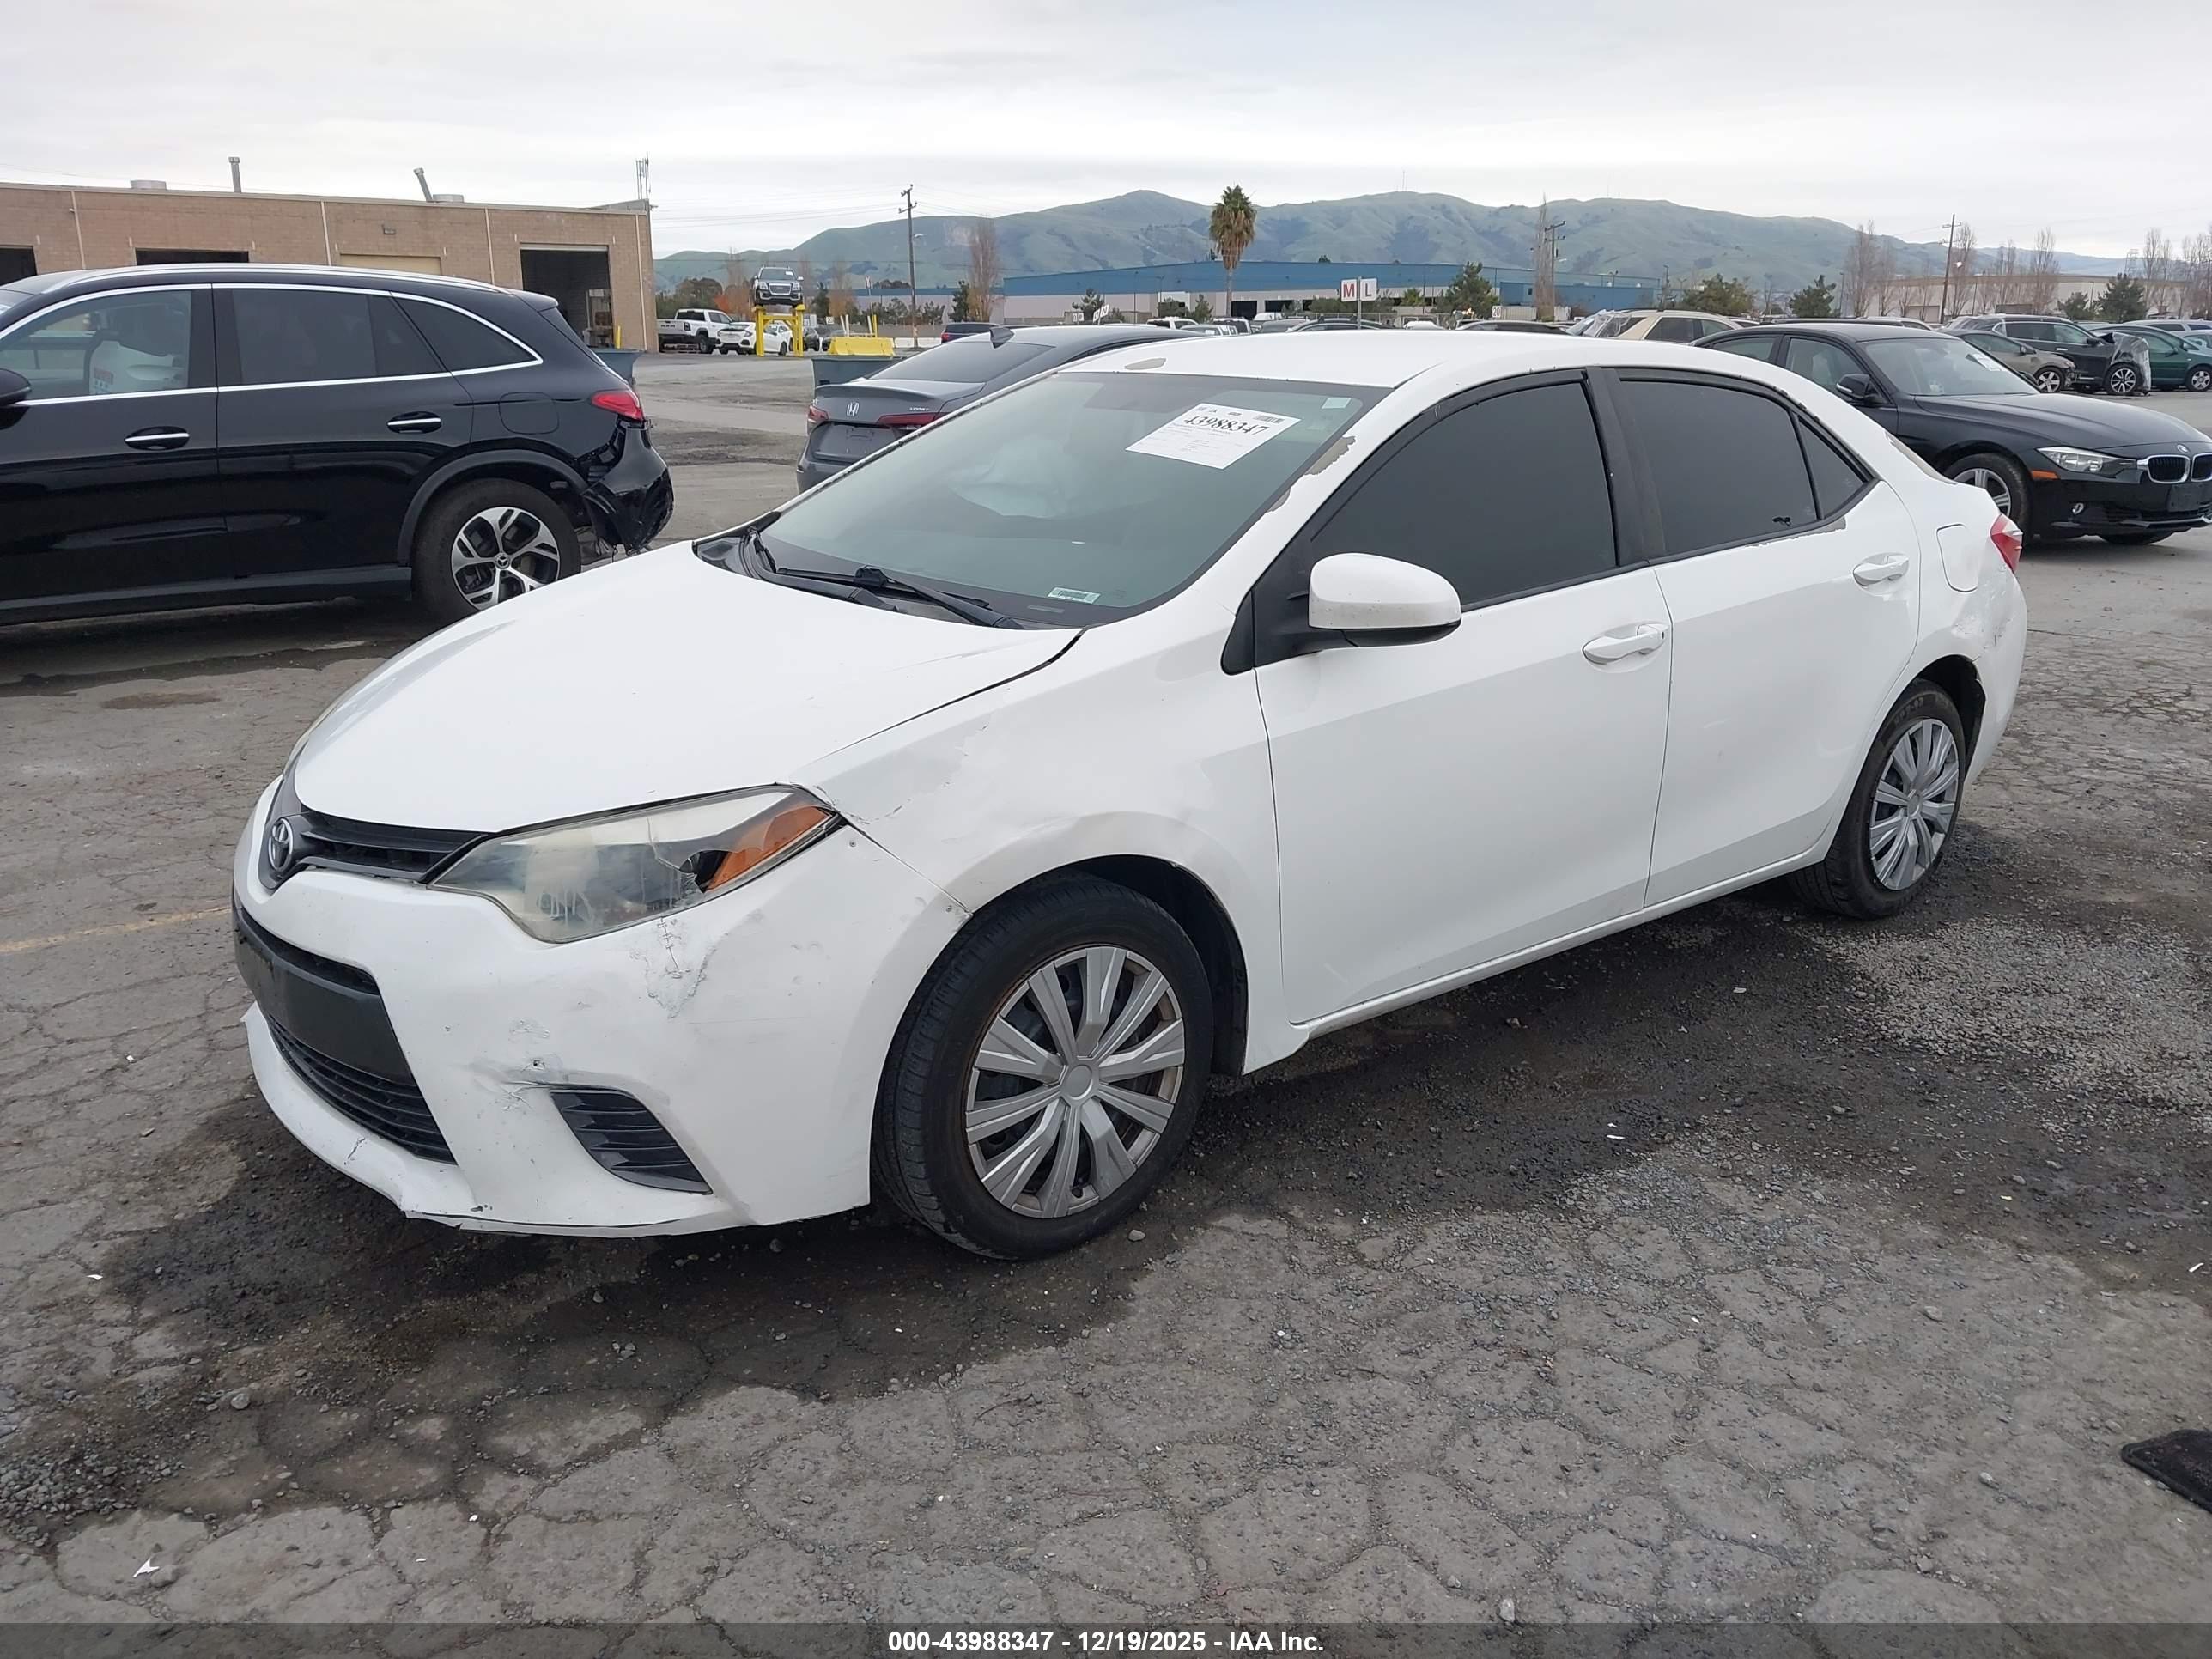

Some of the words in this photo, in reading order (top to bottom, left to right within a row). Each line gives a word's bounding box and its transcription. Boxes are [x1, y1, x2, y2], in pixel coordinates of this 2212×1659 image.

[1343, 283, 1355, 298] M
[1364, 283, 1372, 297] L
[1492, 307, 1501, 317] 20
[1183, 415, 1271, 435] 43988347
